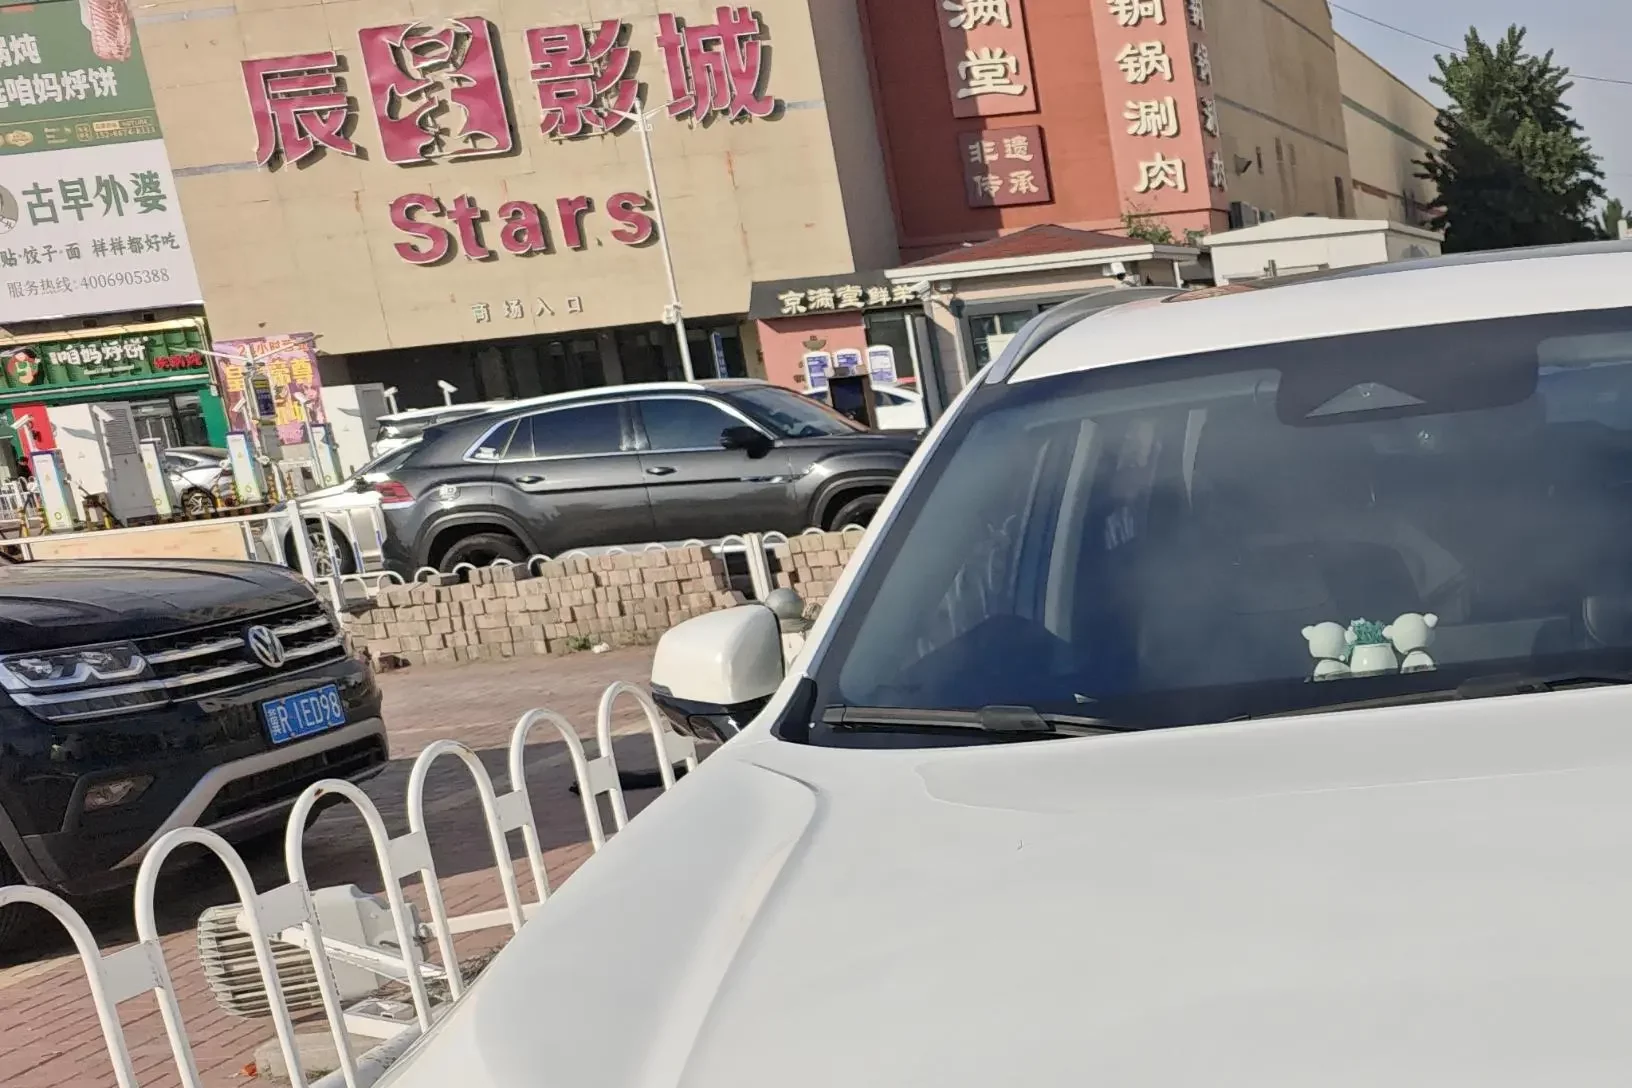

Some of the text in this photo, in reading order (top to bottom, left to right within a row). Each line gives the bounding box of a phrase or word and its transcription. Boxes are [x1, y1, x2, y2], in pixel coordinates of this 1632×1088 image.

[1108, 0, 1186, 193] 铜锅涮肉
[968, 135, 1034, 165] 非遗
[22, 170, 168, 226] 古早外婆
[971, 170, 1040, 198] 传承
[388, 191, 660, 265] Stars
[91, 232, 180, 258] 样样都好吃
[471, 296, 584, 323] 商场入口
